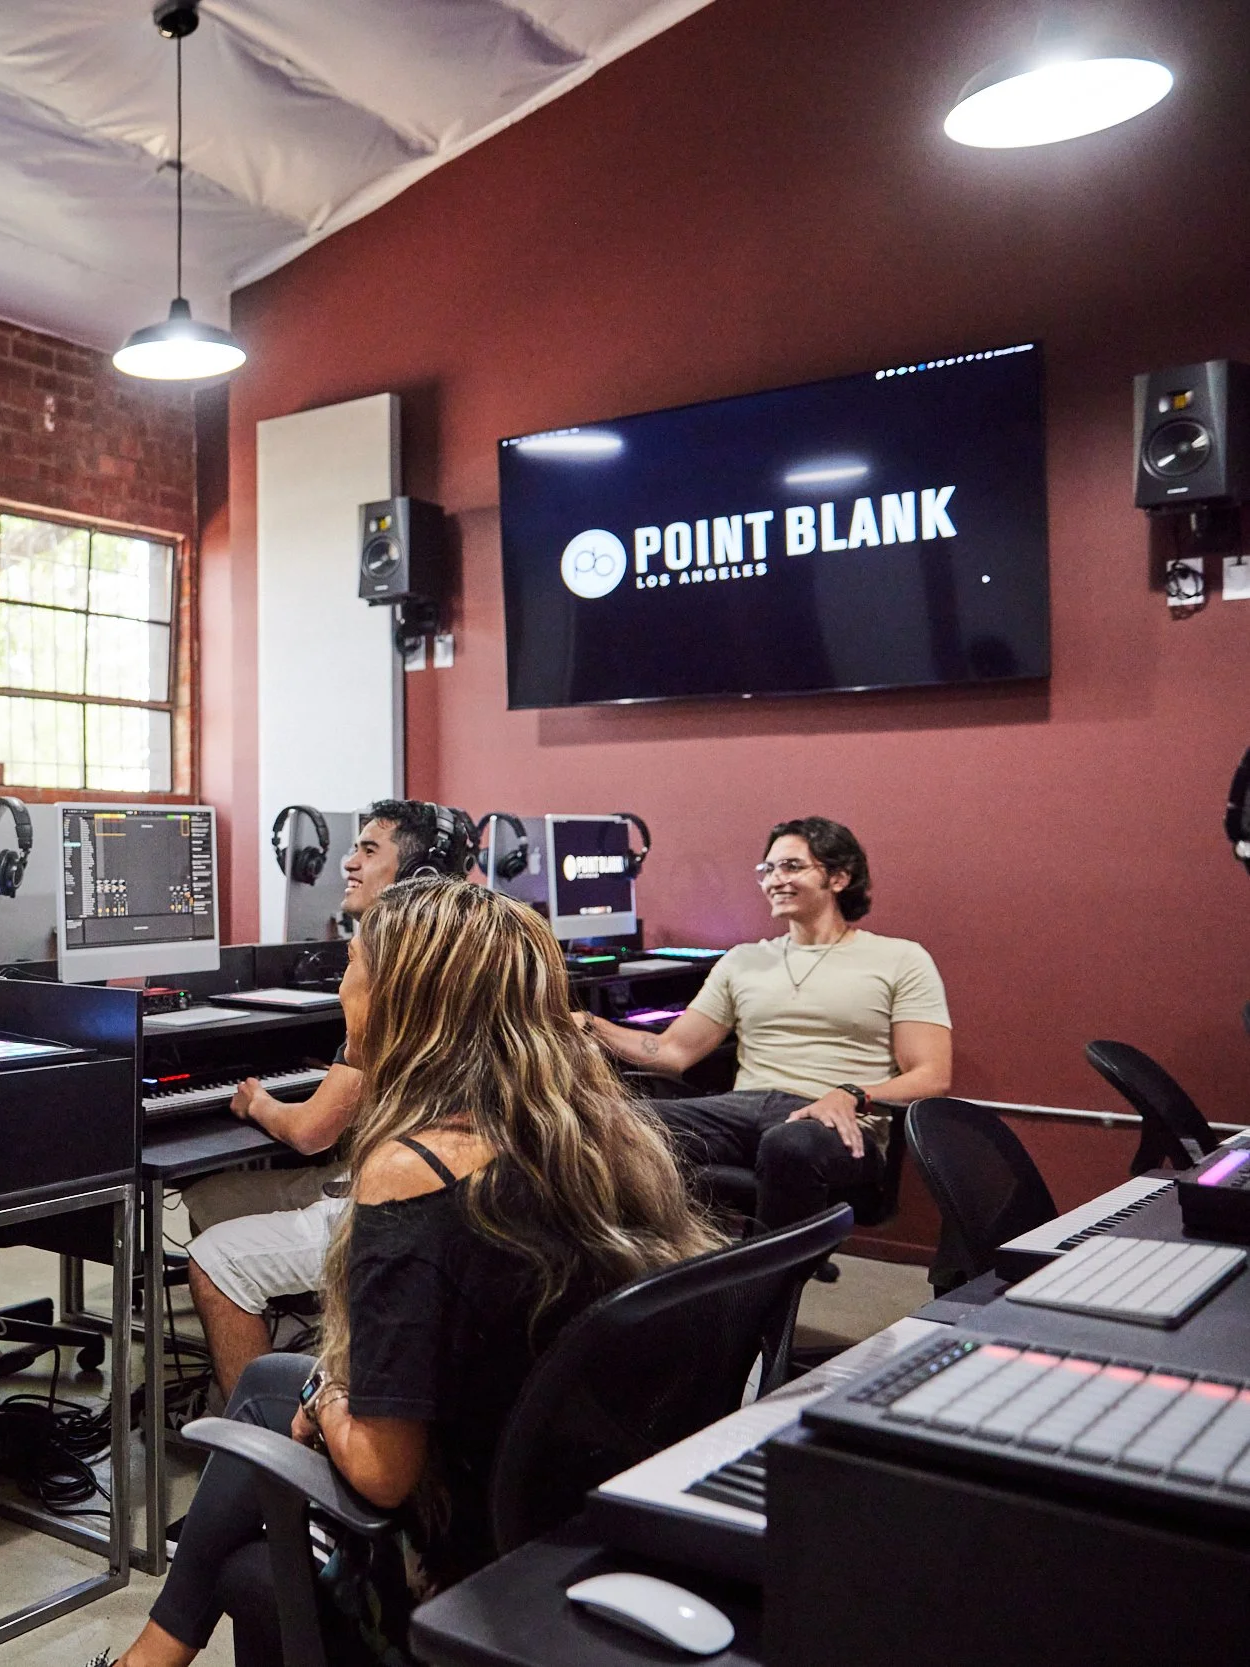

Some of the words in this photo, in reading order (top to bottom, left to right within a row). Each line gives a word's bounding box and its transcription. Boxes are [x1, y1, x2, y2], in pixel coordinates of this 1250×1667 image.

[634, 510, 775, 574] POINT
[784, 485, 958, 556] BLANK
[635, 572, 671, 590] LOS
[678, 562, 768, 586] ANGELES
